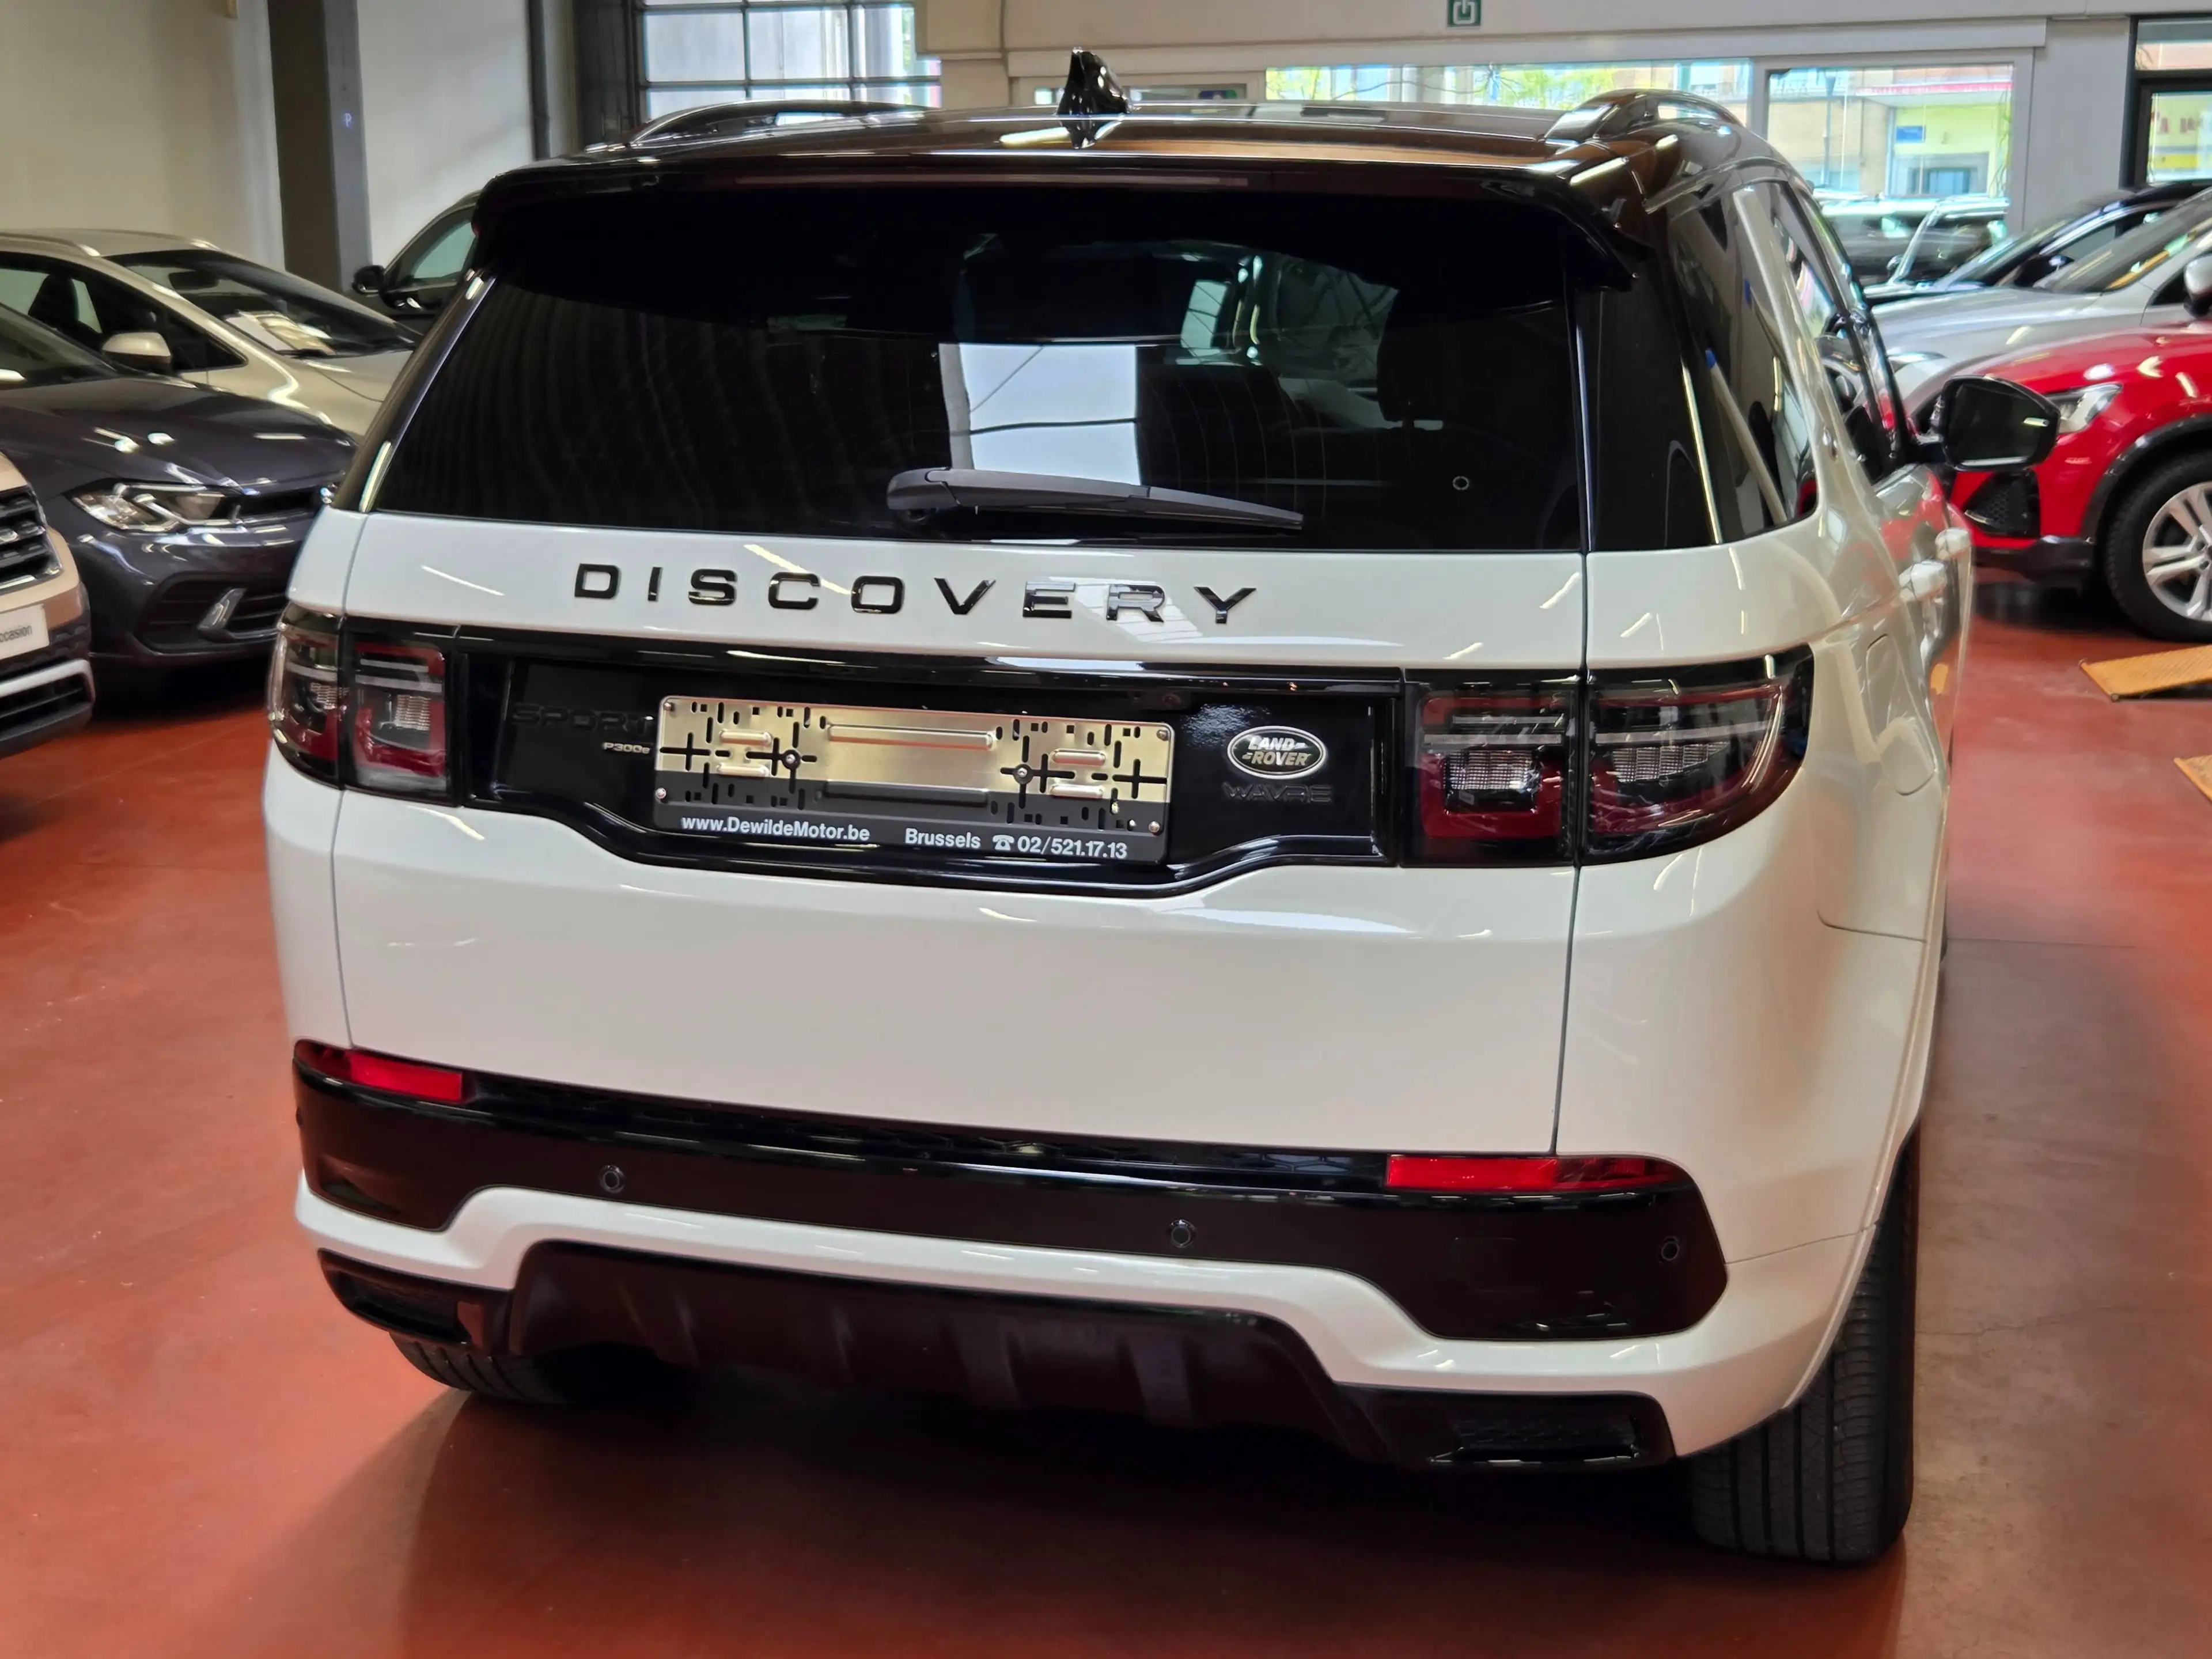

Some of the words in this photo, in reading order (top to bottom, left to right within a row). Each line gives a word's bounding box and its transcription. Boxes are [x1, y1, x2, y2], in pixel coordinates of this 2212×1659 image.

[574, 562, 1257, 625] DISCOVERY
[603, 742, 650, 754] P300e
[1248, 737, 1295, 751] LAND
[1251, 751, 1310, 766] ROVER
[1221, 782, 1332, 803] WAVRE
[681, 816, 870, 841] www.DewildeMotor.be
[905, 828, 981, 849] Brussels
[1017, 835, 1127, 858] 02/521.17.13
